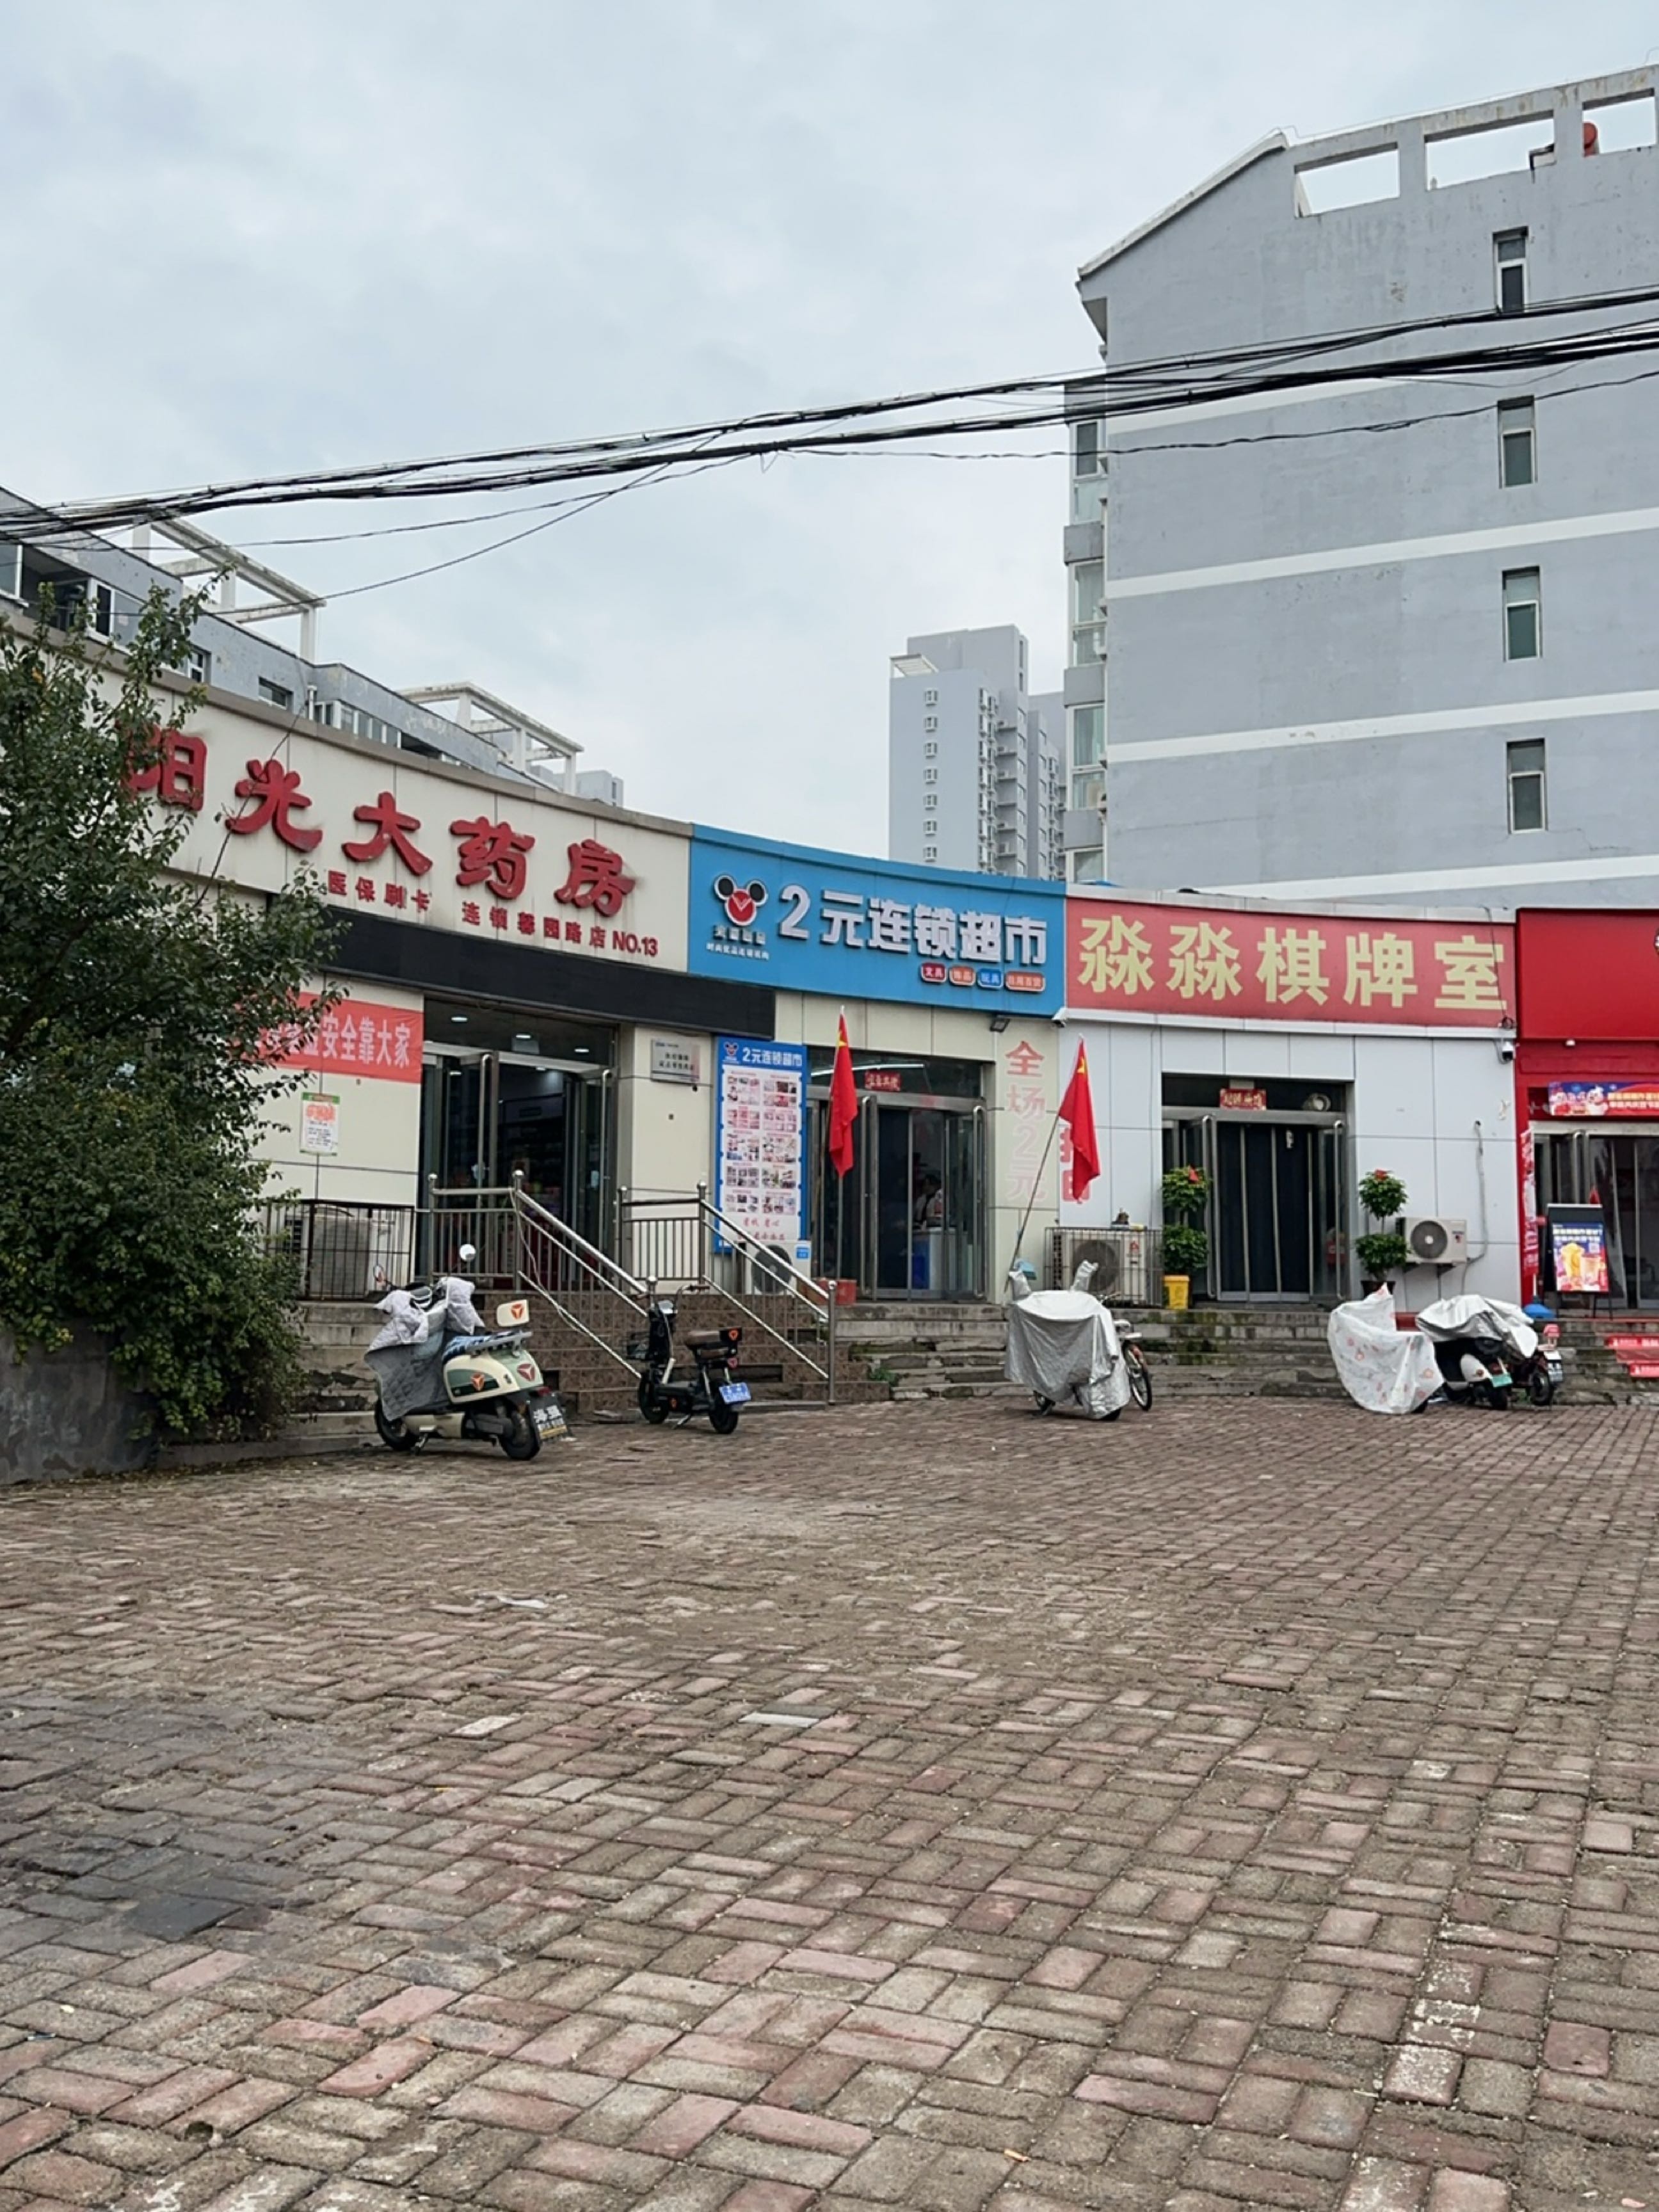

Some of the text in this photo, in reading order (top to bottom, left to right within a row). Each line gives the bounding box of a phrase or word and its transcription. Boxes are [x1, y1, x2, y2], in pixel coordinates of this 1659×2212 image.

[120, 722, 636, 918] 阳光大药房
[328, 870, 431, 912] 医保刷卡
[778, 885, 1047, 965] 2元连锁超市
[1078, 915, 1508, 1011] 淼淼棋牌室
[1006, 1041, 1047, 1202] 全场2元
